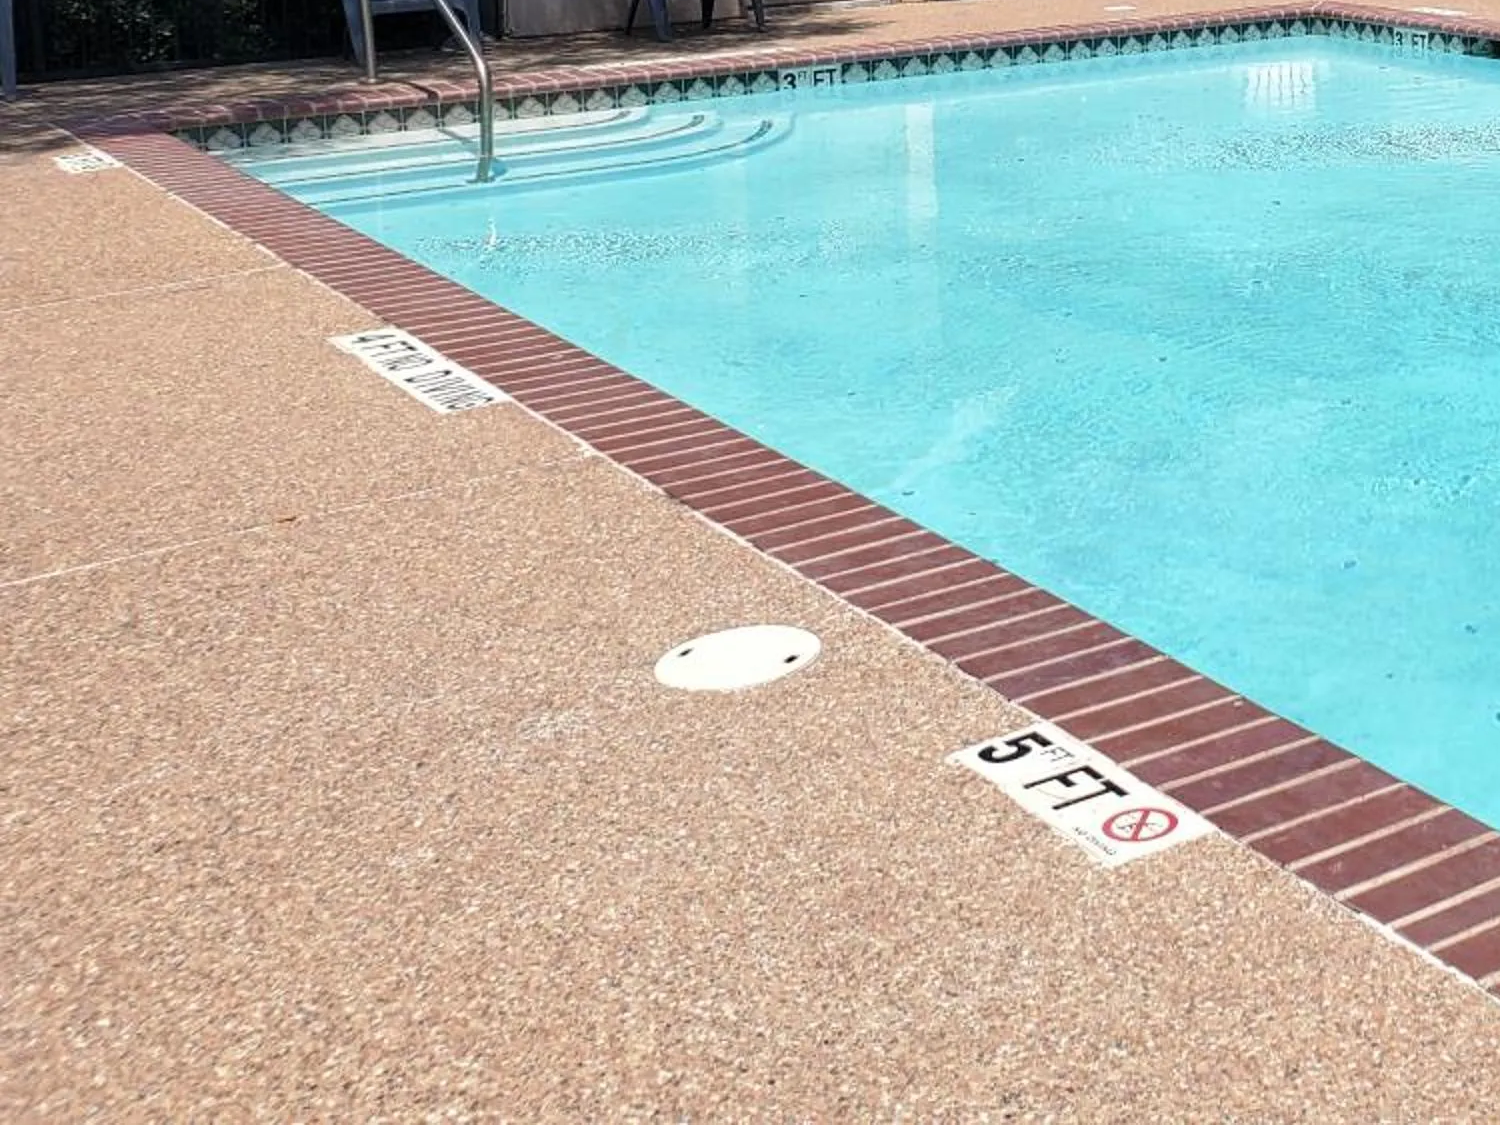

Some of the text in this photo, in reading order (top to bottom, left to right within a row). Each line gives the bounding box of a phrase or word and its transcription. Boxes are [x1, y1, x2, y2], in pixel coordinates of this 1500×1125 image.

[783, 68, 837, 90] 3 FT
[403, 369, 495, 410] DIVING
[977, 731, 1130, 811] 5 FT
